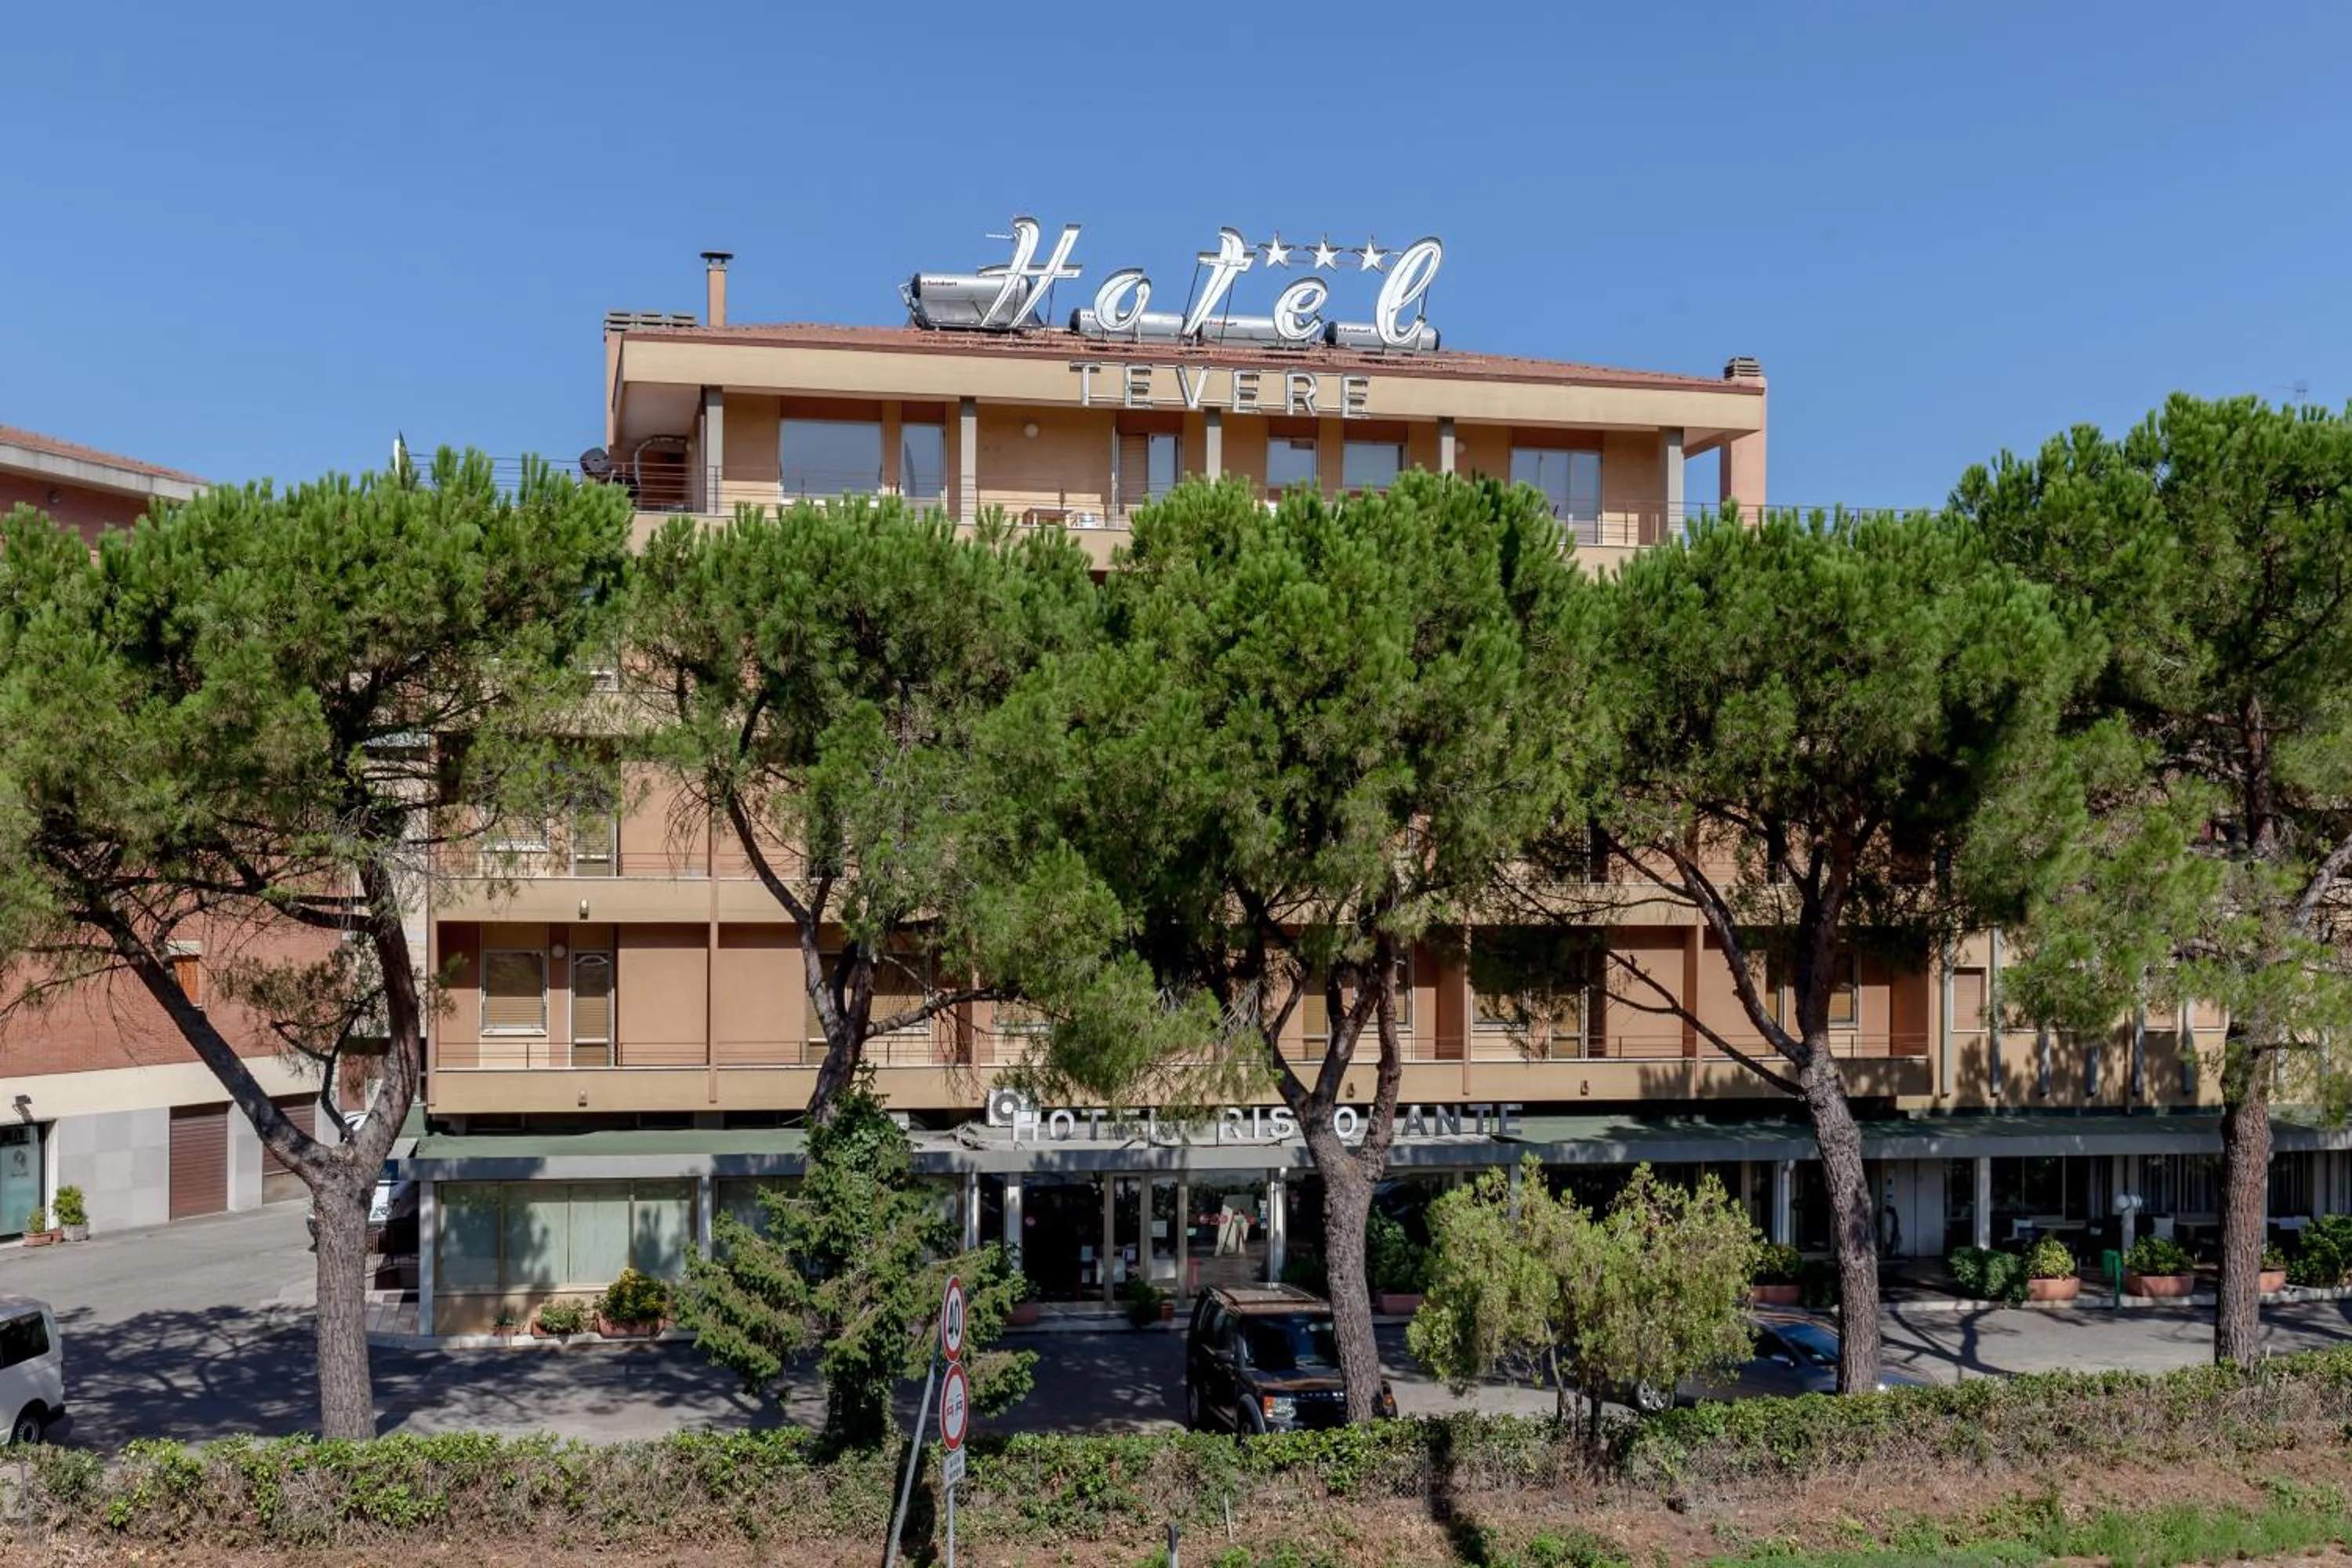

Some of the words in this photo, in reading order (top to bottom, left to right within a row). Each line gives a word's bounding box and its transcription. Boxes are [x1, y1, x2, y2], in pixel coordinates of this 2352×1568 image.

[978, 216, 1443, 344] Hotel
[1069, 361, 1370, 419] TEVERE
[1219, 1103, 1523, 1141] RISOANTE
[948, 1298, 960, 1338] 40
